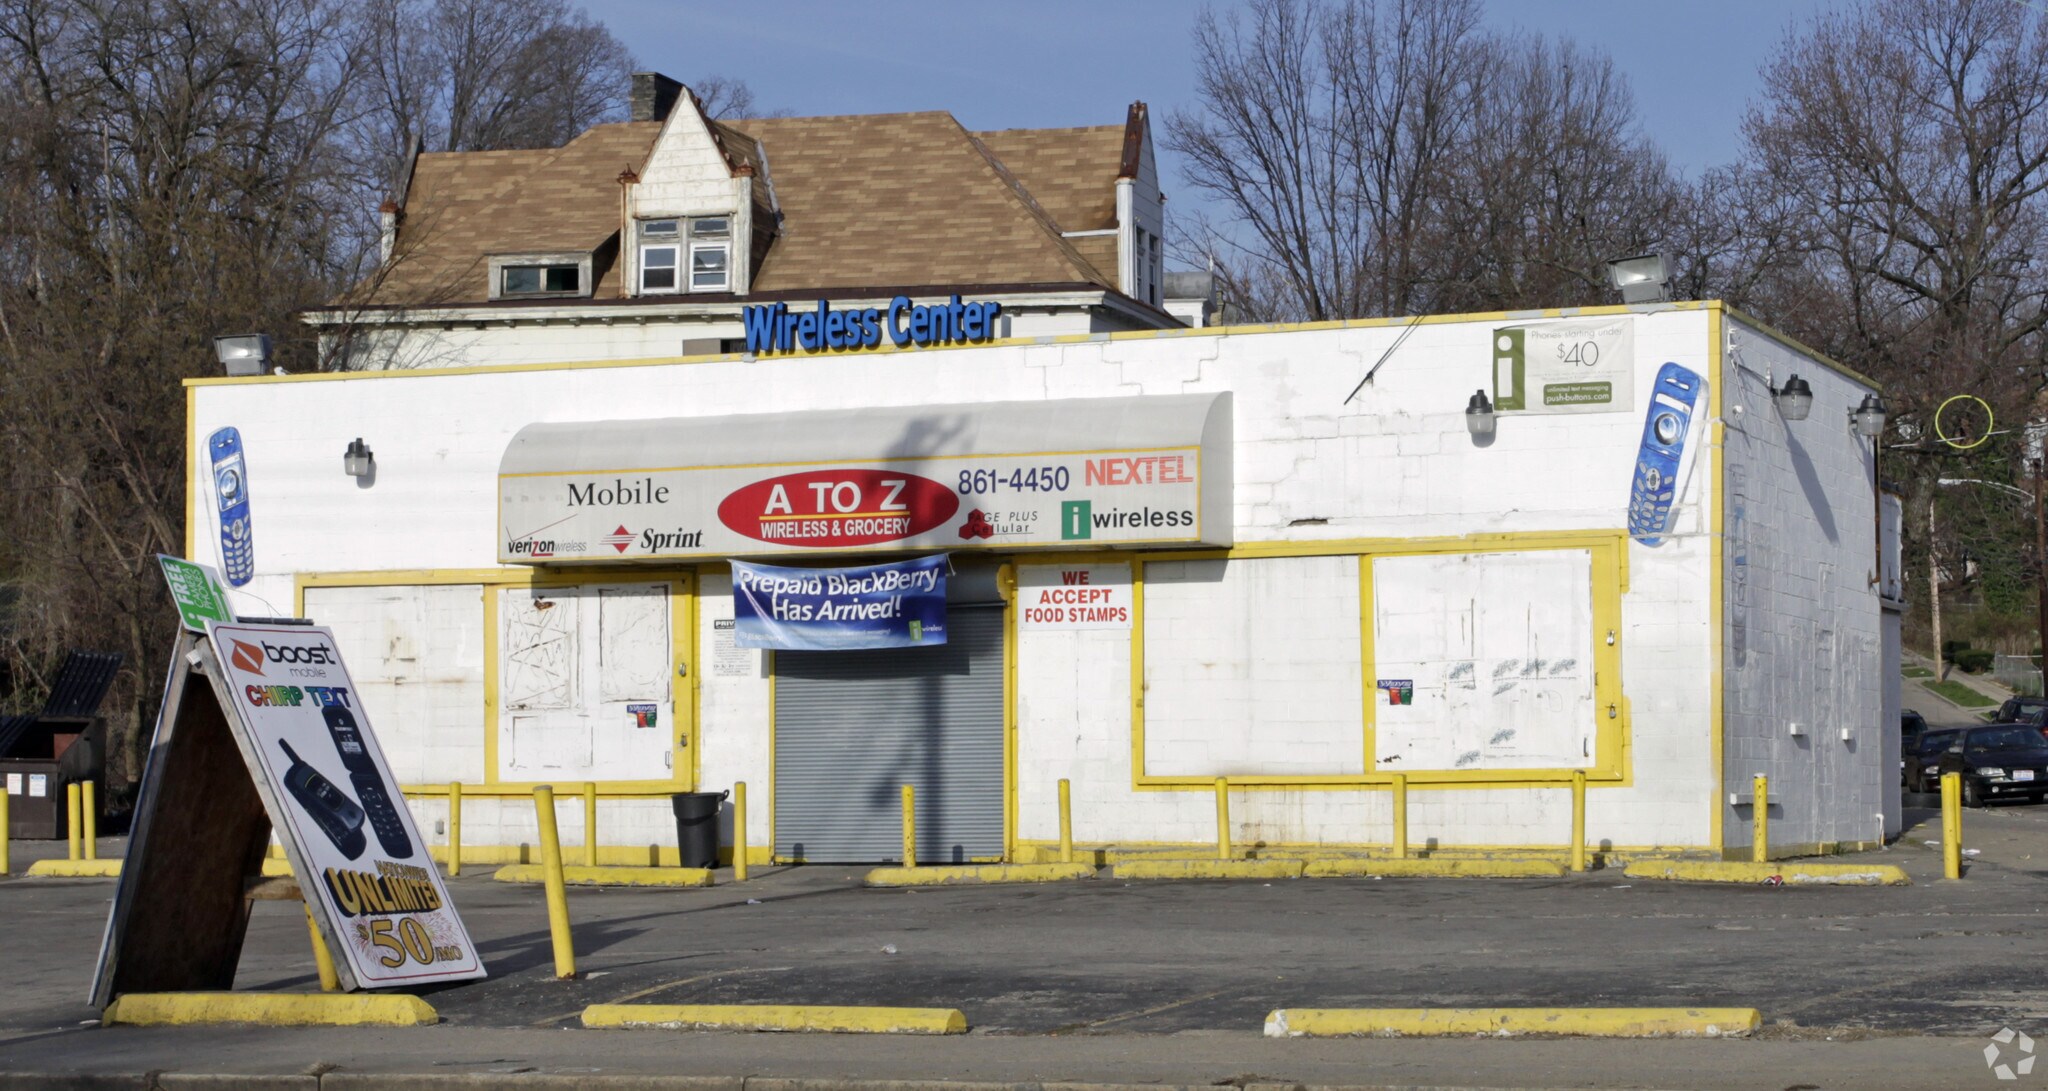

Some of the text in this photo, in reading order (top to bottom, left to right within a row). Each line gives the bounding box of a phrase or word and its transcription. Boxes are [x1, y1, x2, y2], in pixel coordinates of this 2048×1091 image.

[743, 295, 1000, 352] Wireless Center
[1531, 327, 1624, 340] Phones starting under
[1557, 341, 1599, 367] $40
[1546, 392, 1610, 405] push-buttons.com
[958, 465, 1069, 495] 861-4450
[1085, 456, 1194, 486] NEXTEL
[567, 478, 670, 507] Mobile
[764, 479, 907, 515] A TO Z
[760, 517, 911, 539] WIRELESS & GROCERY
[968, 510, 1038, 523] PAGE PLUS
[972, 523, 1030, 534] Cellular
[1093, 507, 1194, 529] wireless
[641, 527, 703, 554] Sprint
[163, 561, 195, 606] FREE
[739, 567, 940, 598] Prepaid BlackBerry
[1062, 570, 1090, 585] WE
[771, 595, 902, 621] Has Arrived!
[1039, 588, 1112, 604] ACCEPT
[1025, 606, 1127, 623] FOOD STAMPS
[261, 640, 337, 665] boost
[289, 667, 327, 678] mobile
[245, 684, 352, 708] CHIRP TEXT
[323, 866, 443, 918] UNLIMITED
